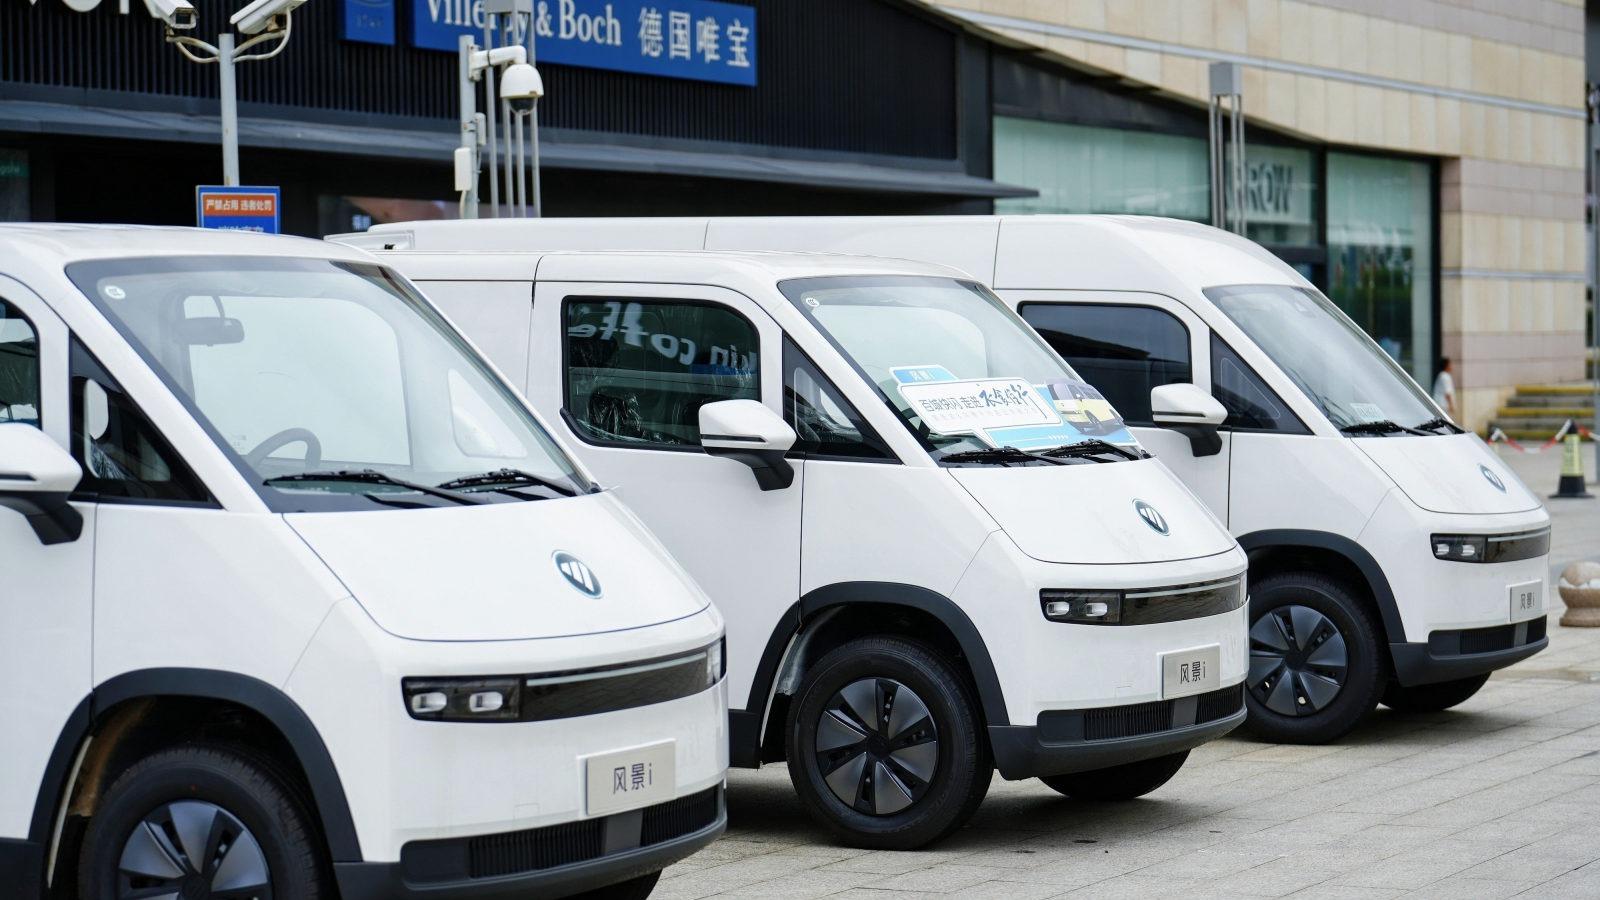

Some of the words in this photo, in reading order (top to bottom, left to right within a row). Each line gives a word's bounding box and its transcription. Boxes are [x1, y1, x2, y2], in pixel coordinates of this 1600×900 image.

[535, 1, 553, 37] &
[559, 0, 622, 46] Boch
[638, 7, 750, 67] 德国唯宝
[1180, 661, 1206, 684] 风景i
[613, 762, 652, 795] 风景i
